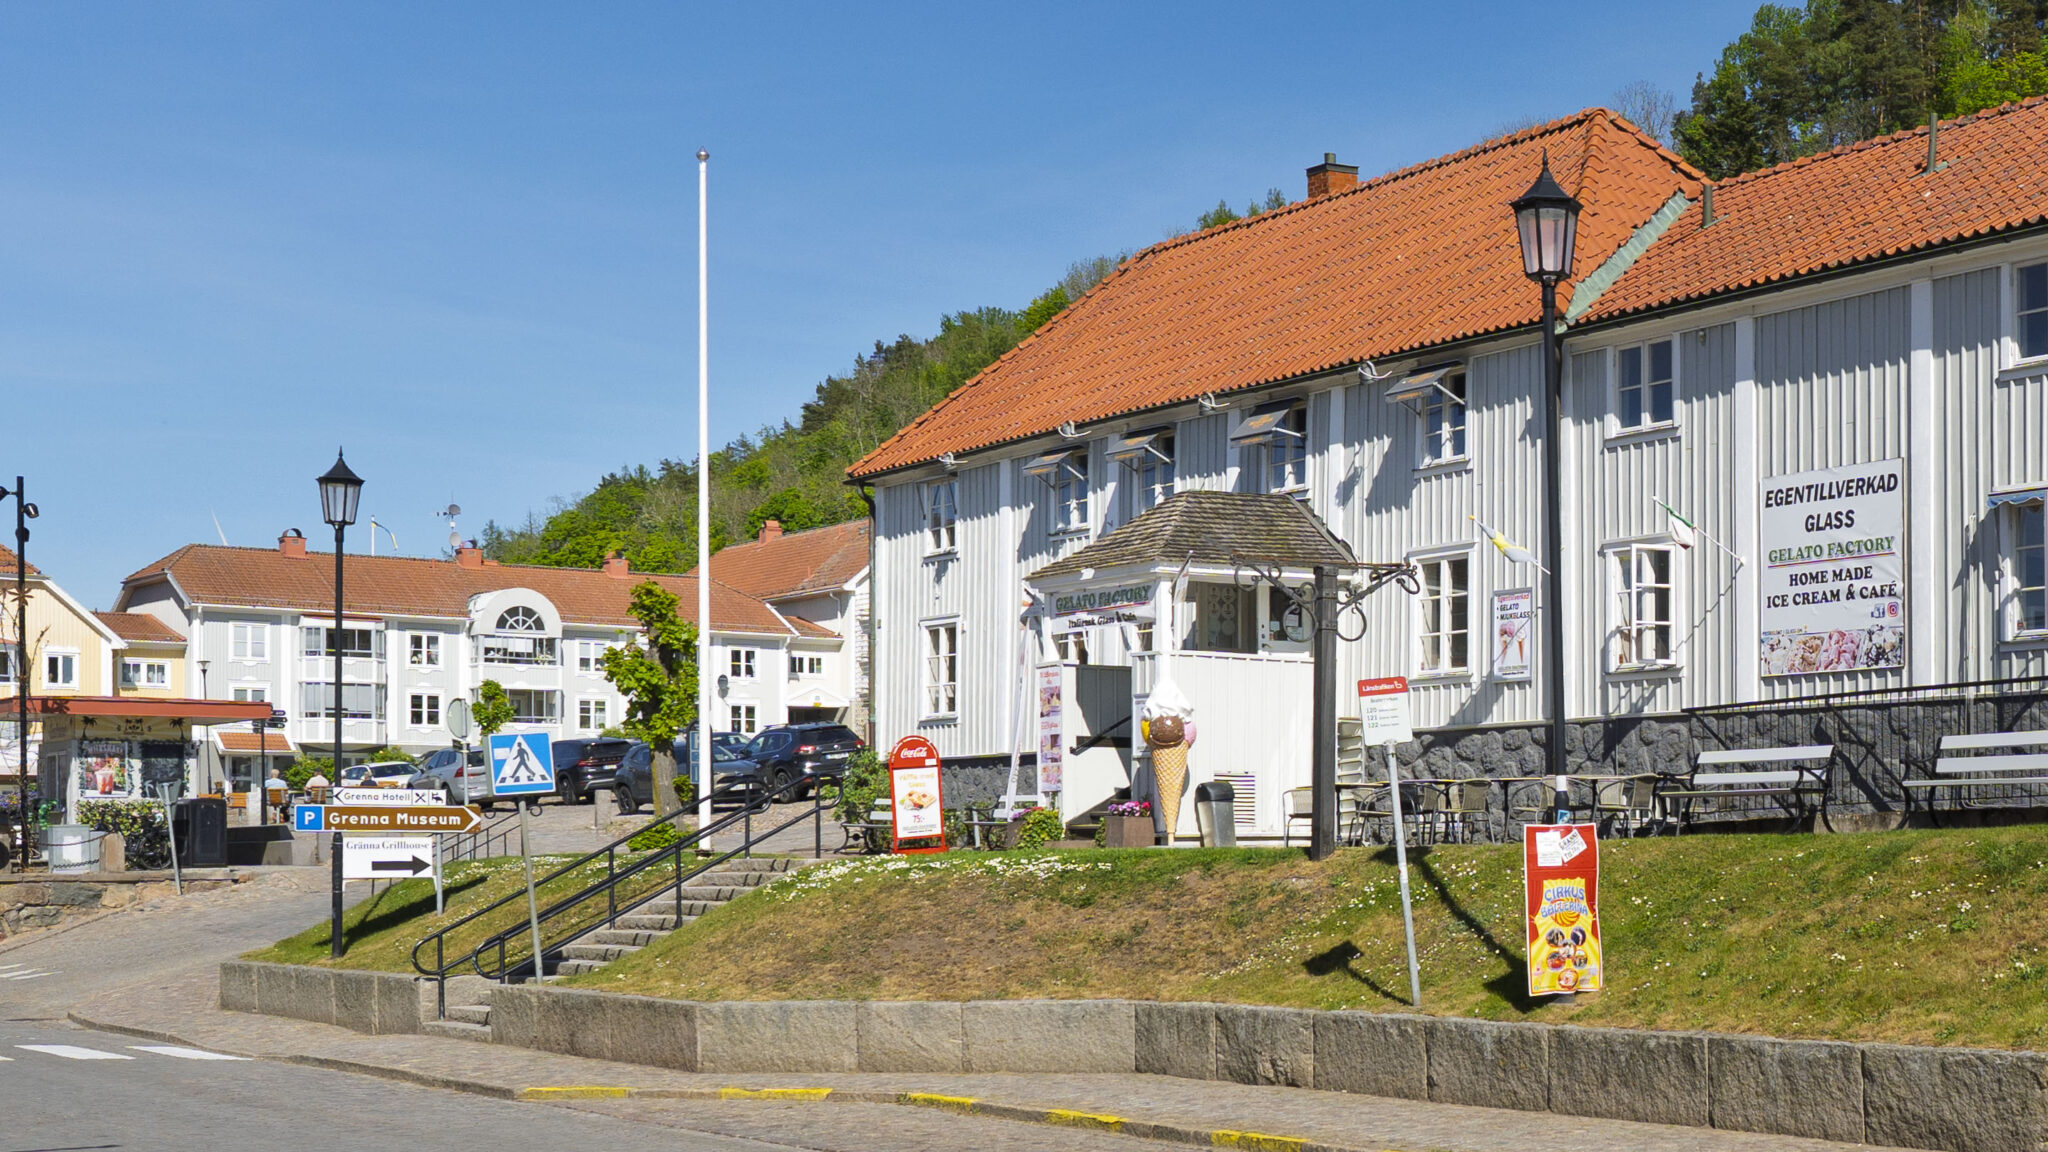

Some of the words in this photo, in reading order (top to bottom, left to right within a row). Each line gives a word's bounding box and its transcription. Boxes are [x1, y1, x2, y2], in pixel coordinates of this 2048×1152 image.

[1765, 473, 1898, 508] EGENTILLVERKAD
[1804, 510, 1855, 533] GLASS
[1768, 543, 1823, 564] GELATO
[1827, 536, 1895, 557] FACTORY
[1789, 570, 1828, 587] HOME
[1831, 566, 1873, 583] MADE
[1056, 593, 1096, 610] GELATO
[1098, 585, 1151, 608] FACTORY
[1766, 595, 1789, 609] ICE
[1792, 589, 1841, 607] CREAM
[1845, 583, 1855, 601] &
[1859, 580, 1897, 600] CAFÉ
[1500, 603, 1520, 612] GELATO
[344, 791, 379, 801] Grenna
[304, 811, 316, 825] P
[328, 811, 390, 826] Grenna
[396, 811, 461, 826] Museum
[346, 840, 380, 851] Gränna
[381, 839, 430, 850] Grillhouse
[1544, 885, 1585, 902] CIRKUS
